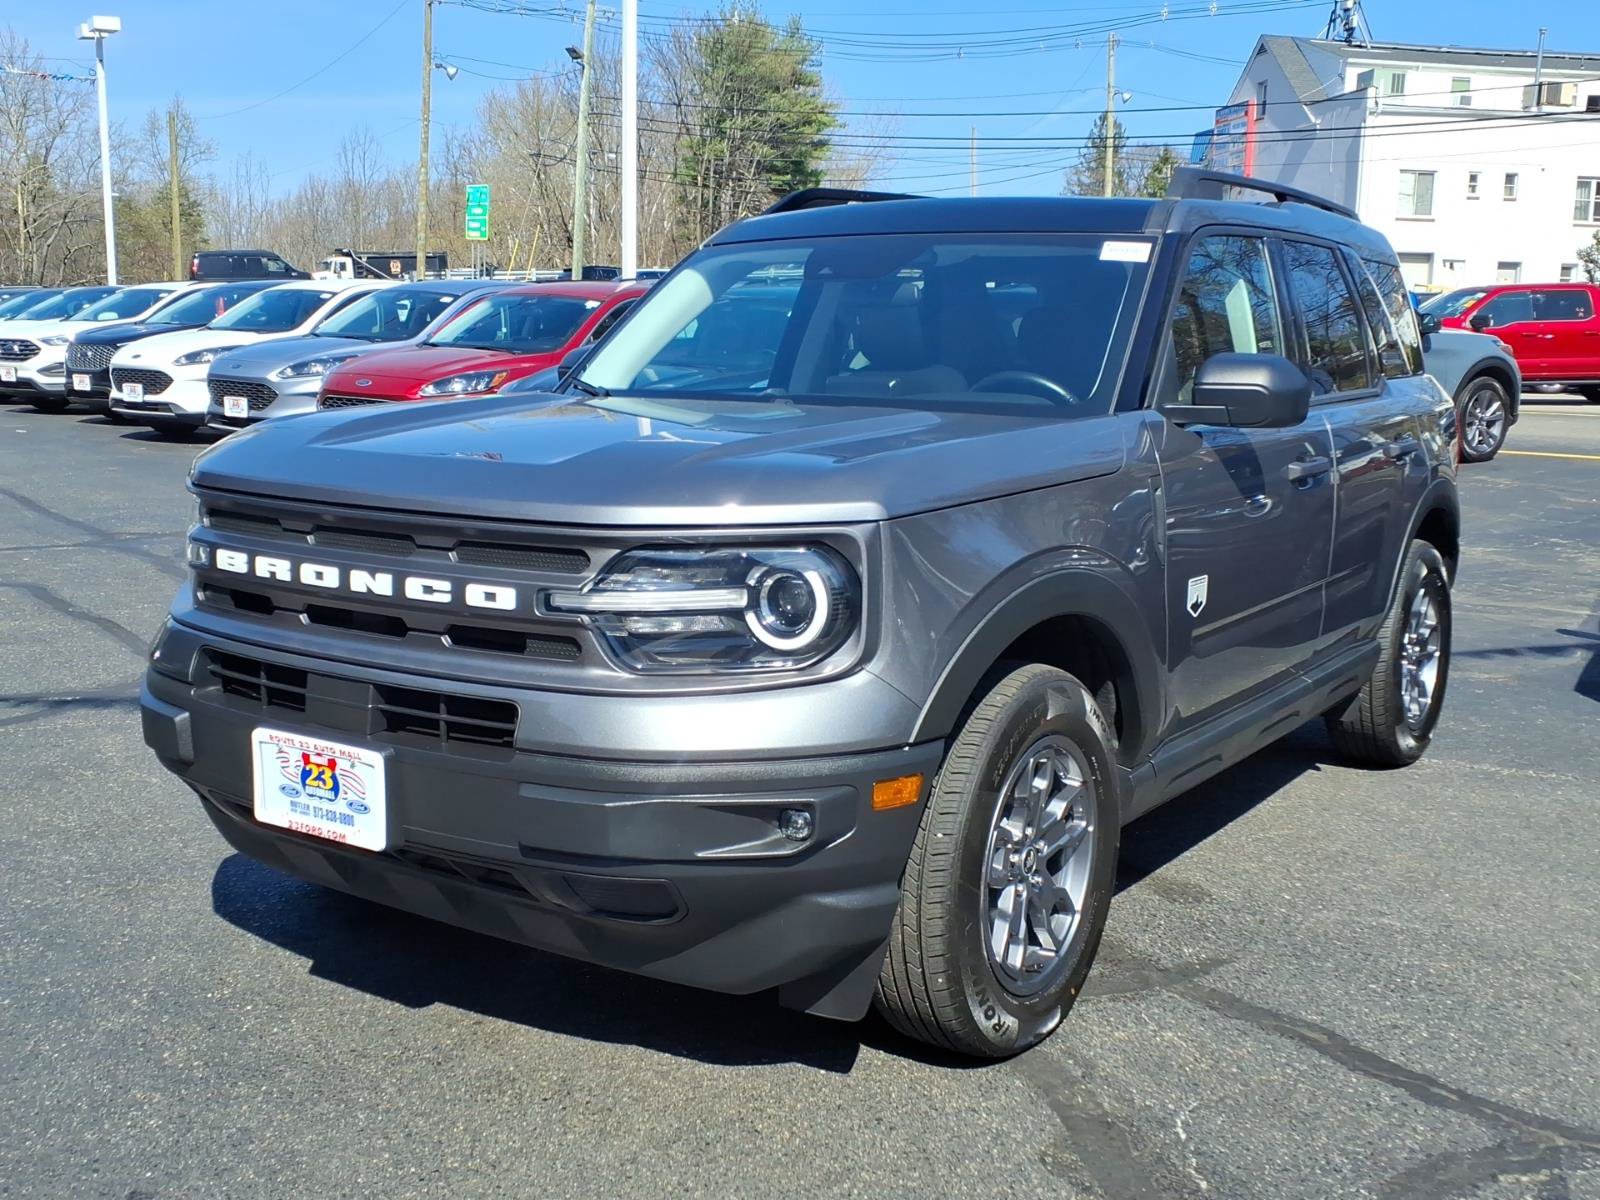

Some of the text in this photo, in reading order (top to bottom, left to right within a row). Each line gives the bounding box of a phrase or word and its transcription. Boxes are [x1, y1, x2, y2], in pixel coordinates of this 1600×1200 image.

[215, 547, 518, 611] BRONCO
[268, 734, 363, 761] ROUTE 23 AUTO MALL
[305, 763, 334, 791] 23
[287, 820, 347, 842] 23FORD.COM
